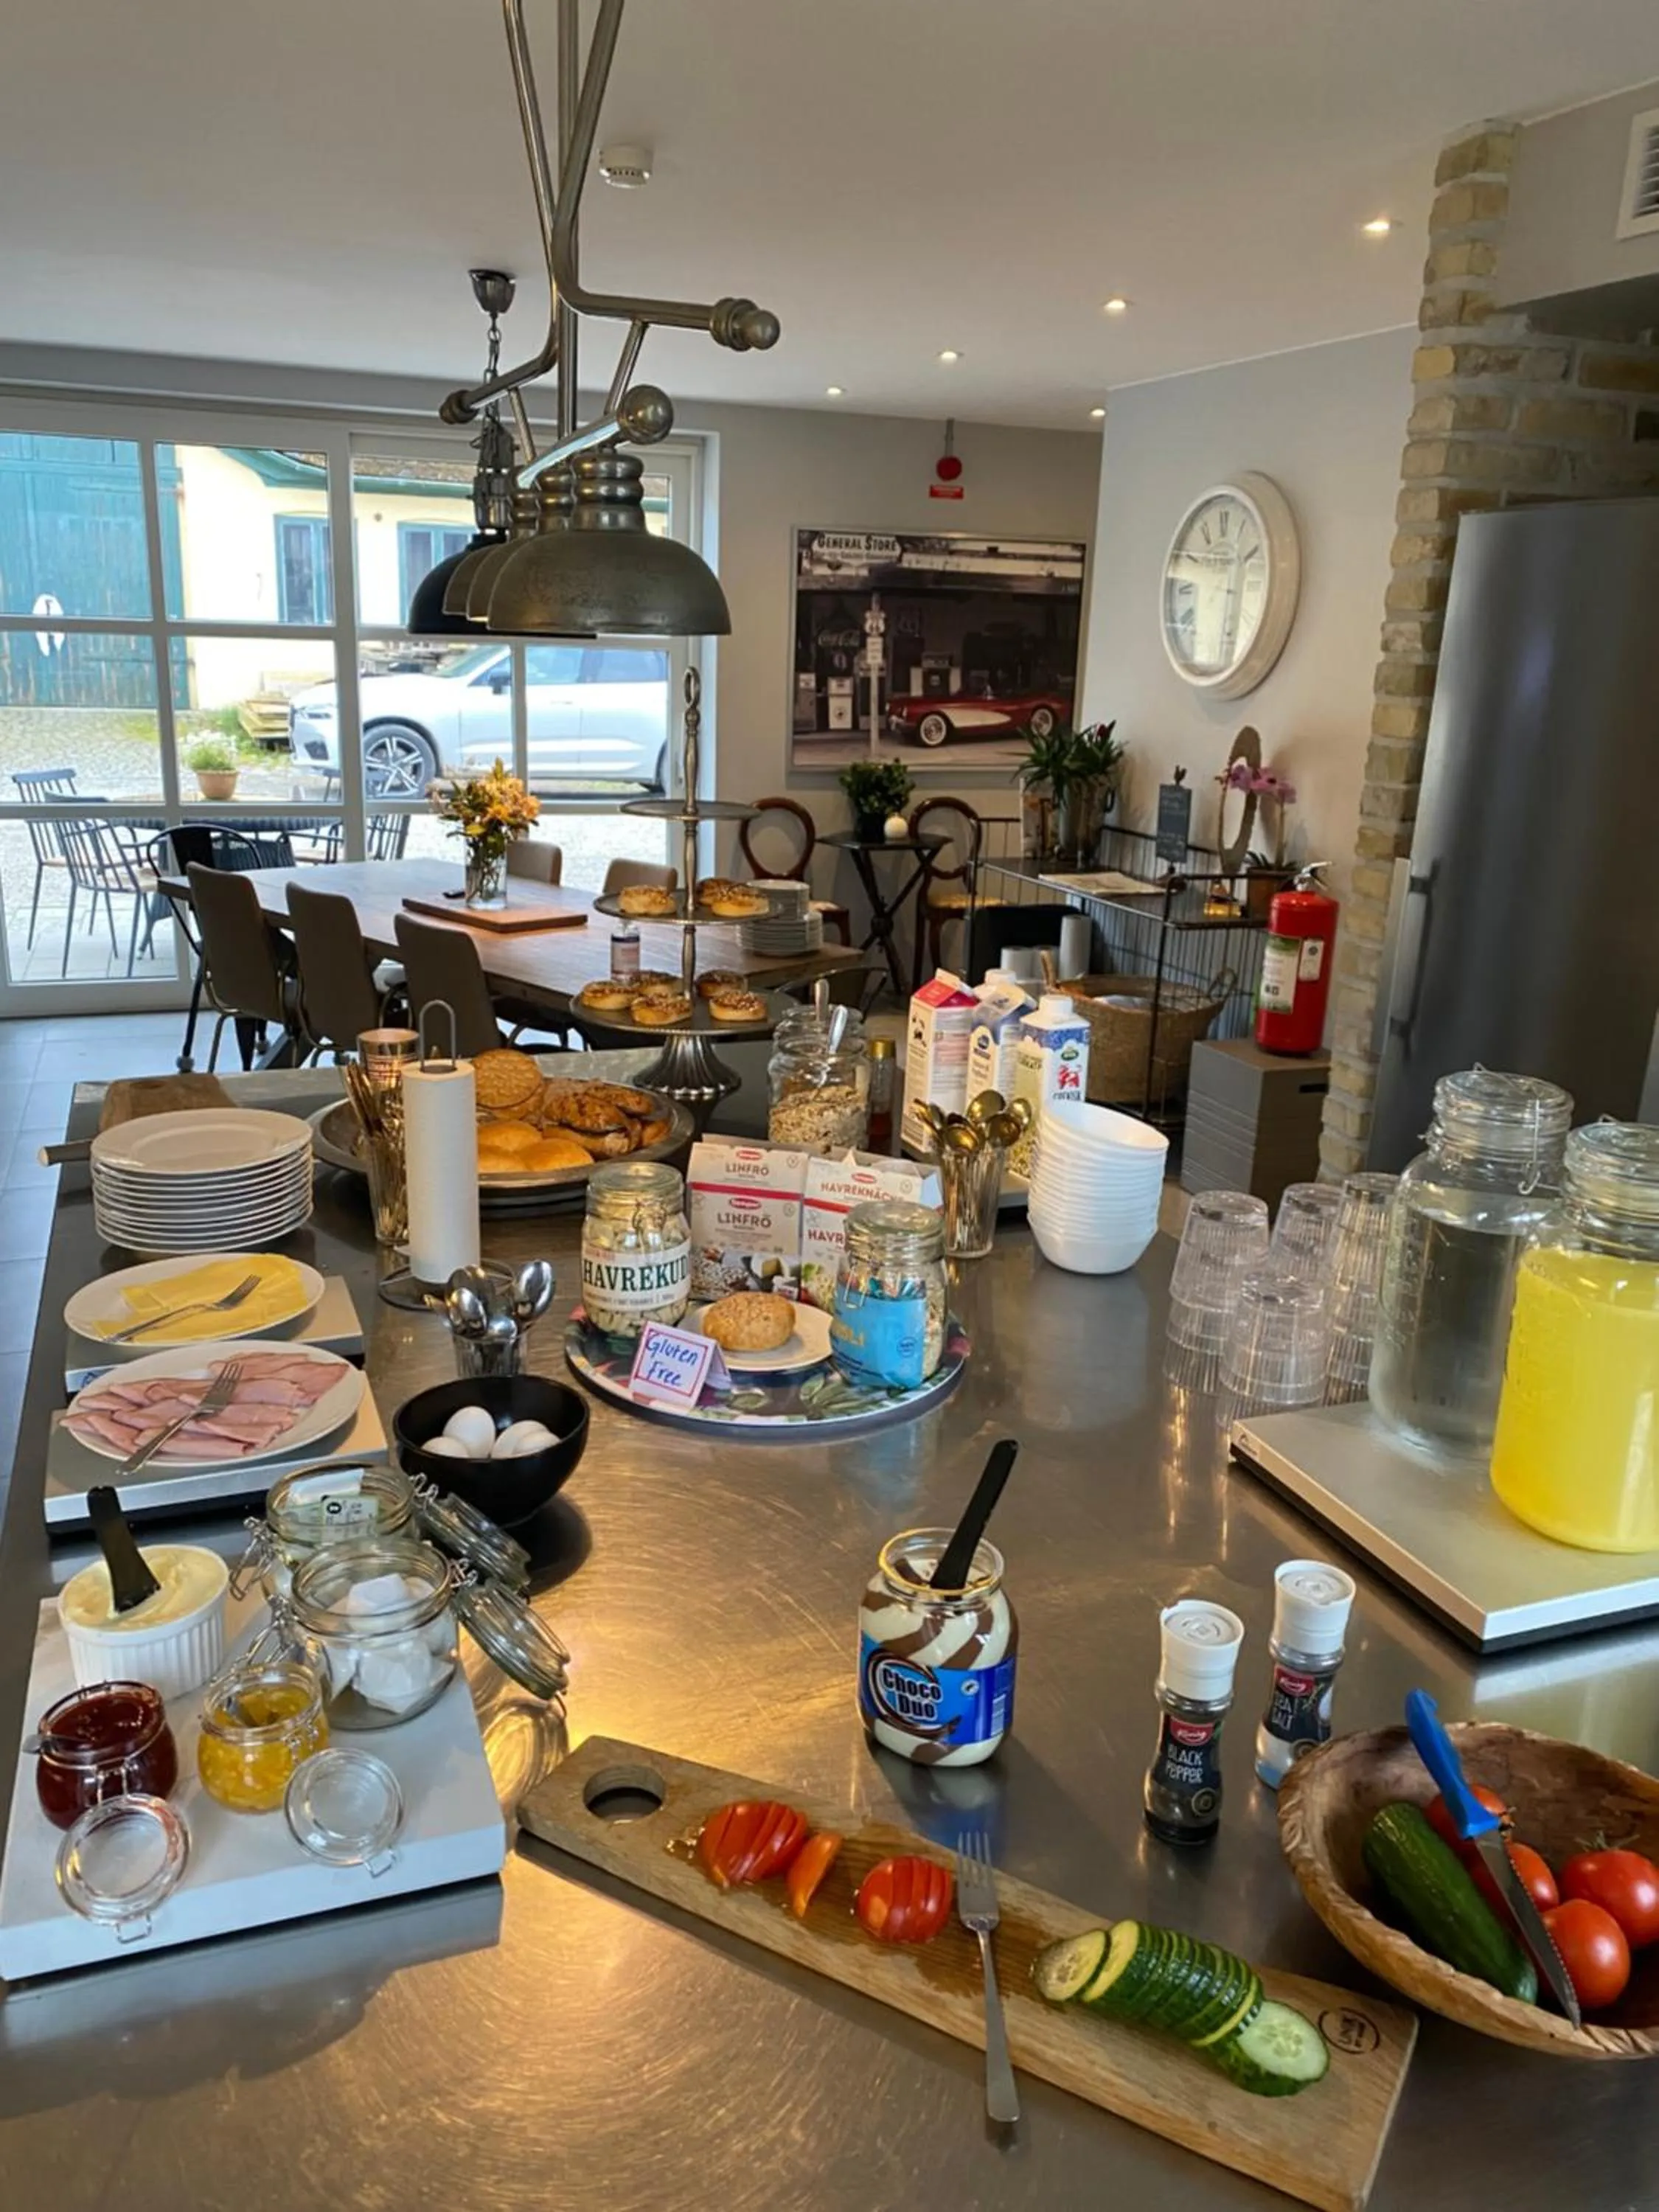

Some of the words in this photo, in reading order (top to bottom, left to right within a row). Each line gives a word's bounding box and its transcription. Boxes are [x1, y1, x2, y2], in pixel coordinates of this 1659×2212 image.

[726, 1162, 770, 1176] LINFRÖ
[717, 1211, 772, 1228] LINFRÖ
[646, 1332, 698, 1366] Gluten
[646, 1360, 681, 1385] Free
[883, 1666, 942, 1700] Choco
[898, 1694, 936, 1718] Duo
[1167, 1744, 1203, 1766] BLACK
